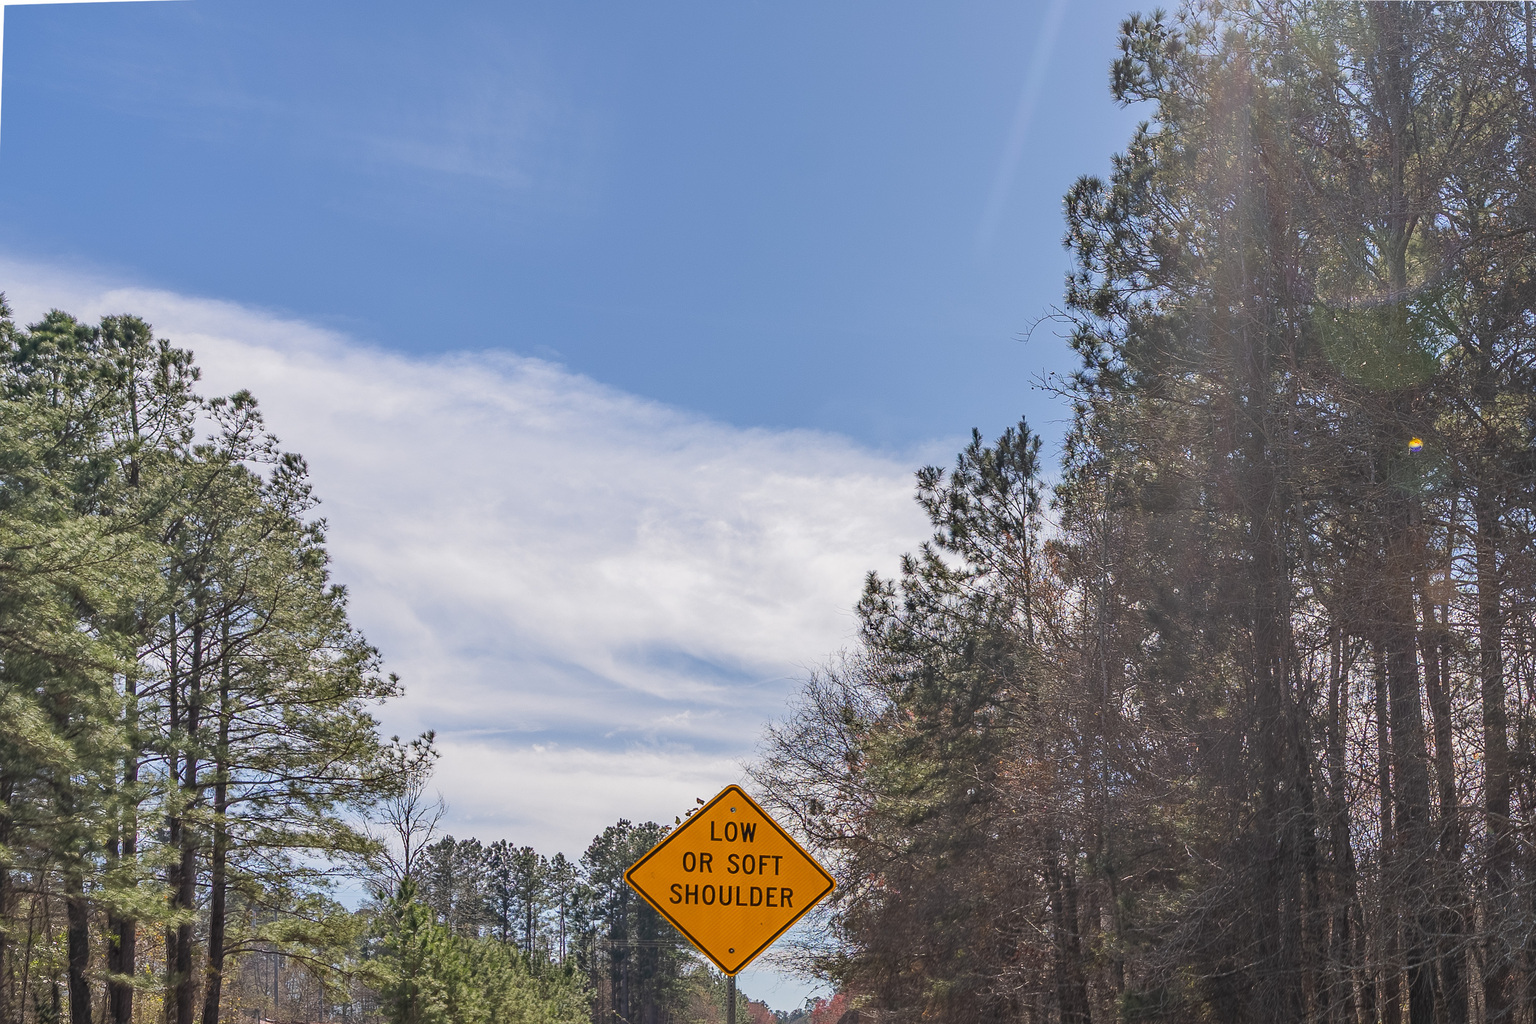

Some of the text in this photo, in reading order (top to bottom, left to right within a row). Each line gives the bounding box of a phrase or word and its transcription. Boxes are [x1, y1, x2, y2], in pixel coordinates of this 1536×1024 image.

[710, 820, 757, 843] LOW
[682, 851, 783, 876] OR SOFT
[669, 883, 794, 908] SHOULDER
